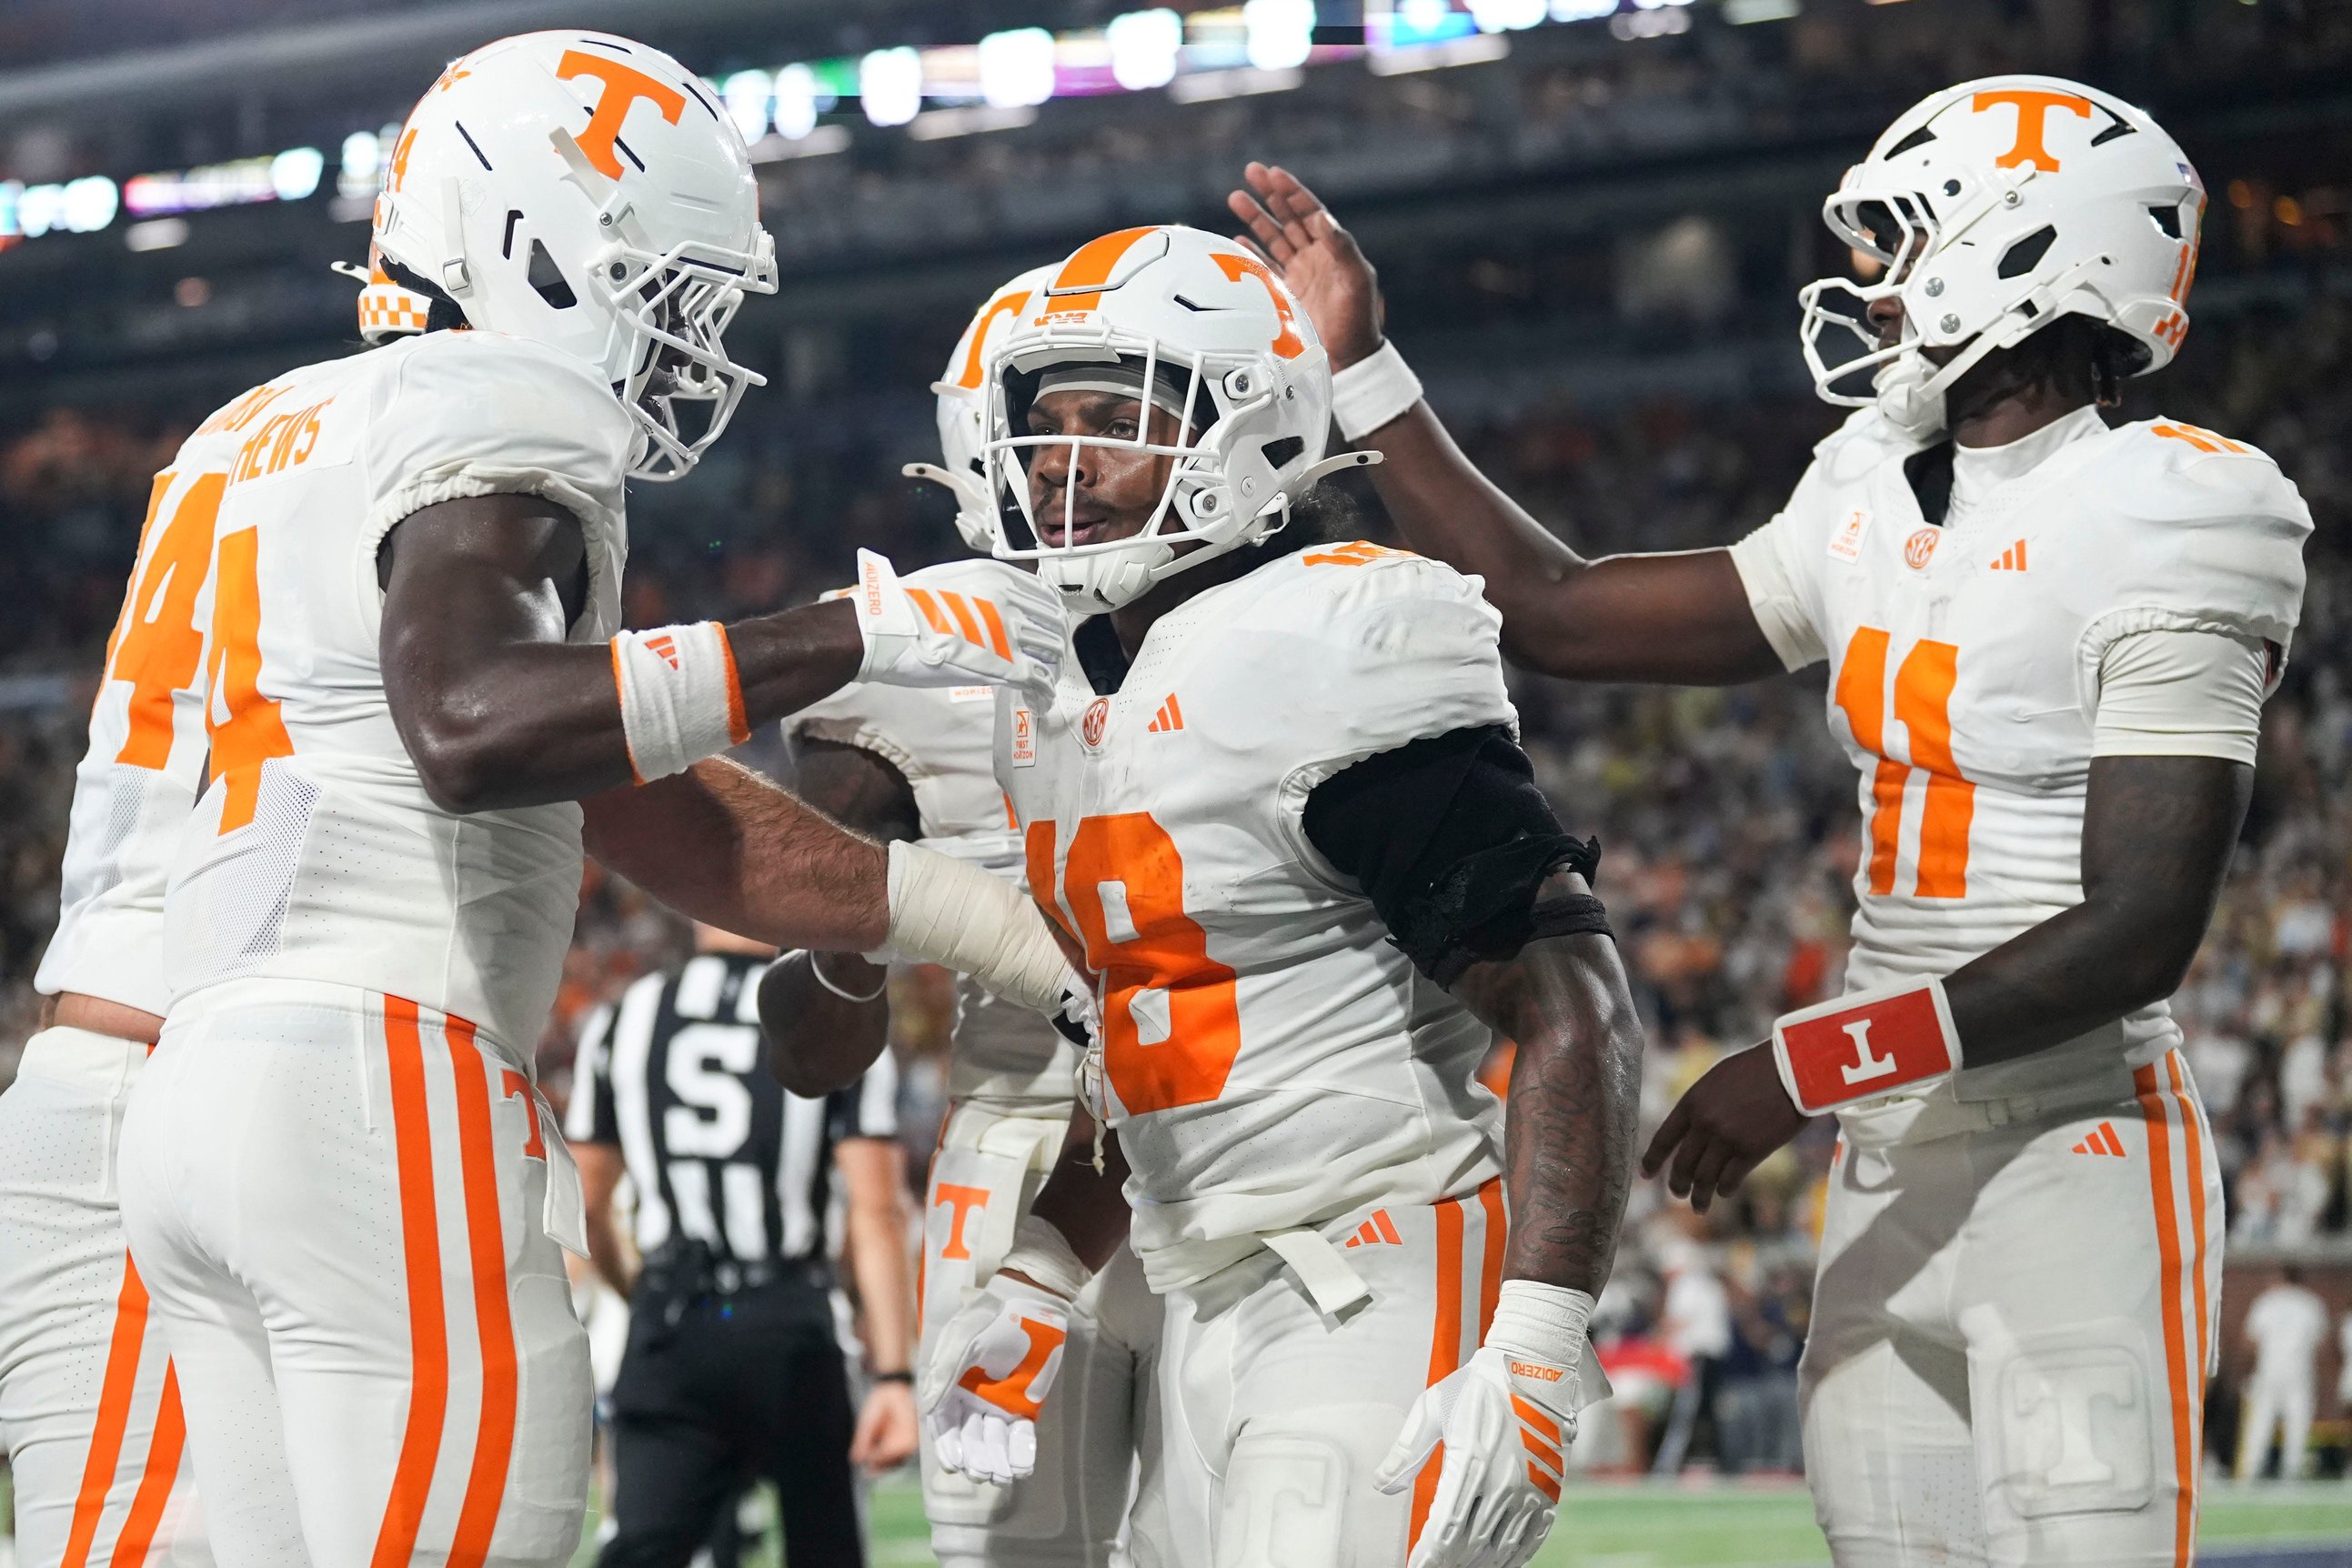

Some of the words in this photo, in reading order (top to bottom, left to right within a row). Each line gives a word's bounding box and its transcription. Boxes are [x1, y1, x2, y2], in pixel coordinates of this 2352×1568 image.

[556, 49, 687, 182] T
[1973, 91, 2091, 172] T
[865, 561, 882, 616] ADIZERO
[1834, 626, 1976, 899] 11
[663, 1021, 760, 1160] S
[1841, 1019, 1897, 1086] T
[935, 1182, 990, 1261] T
[957, 1317, 1067, 1422] T
[1511, 1361, 1563, 1382] ADIZERO
